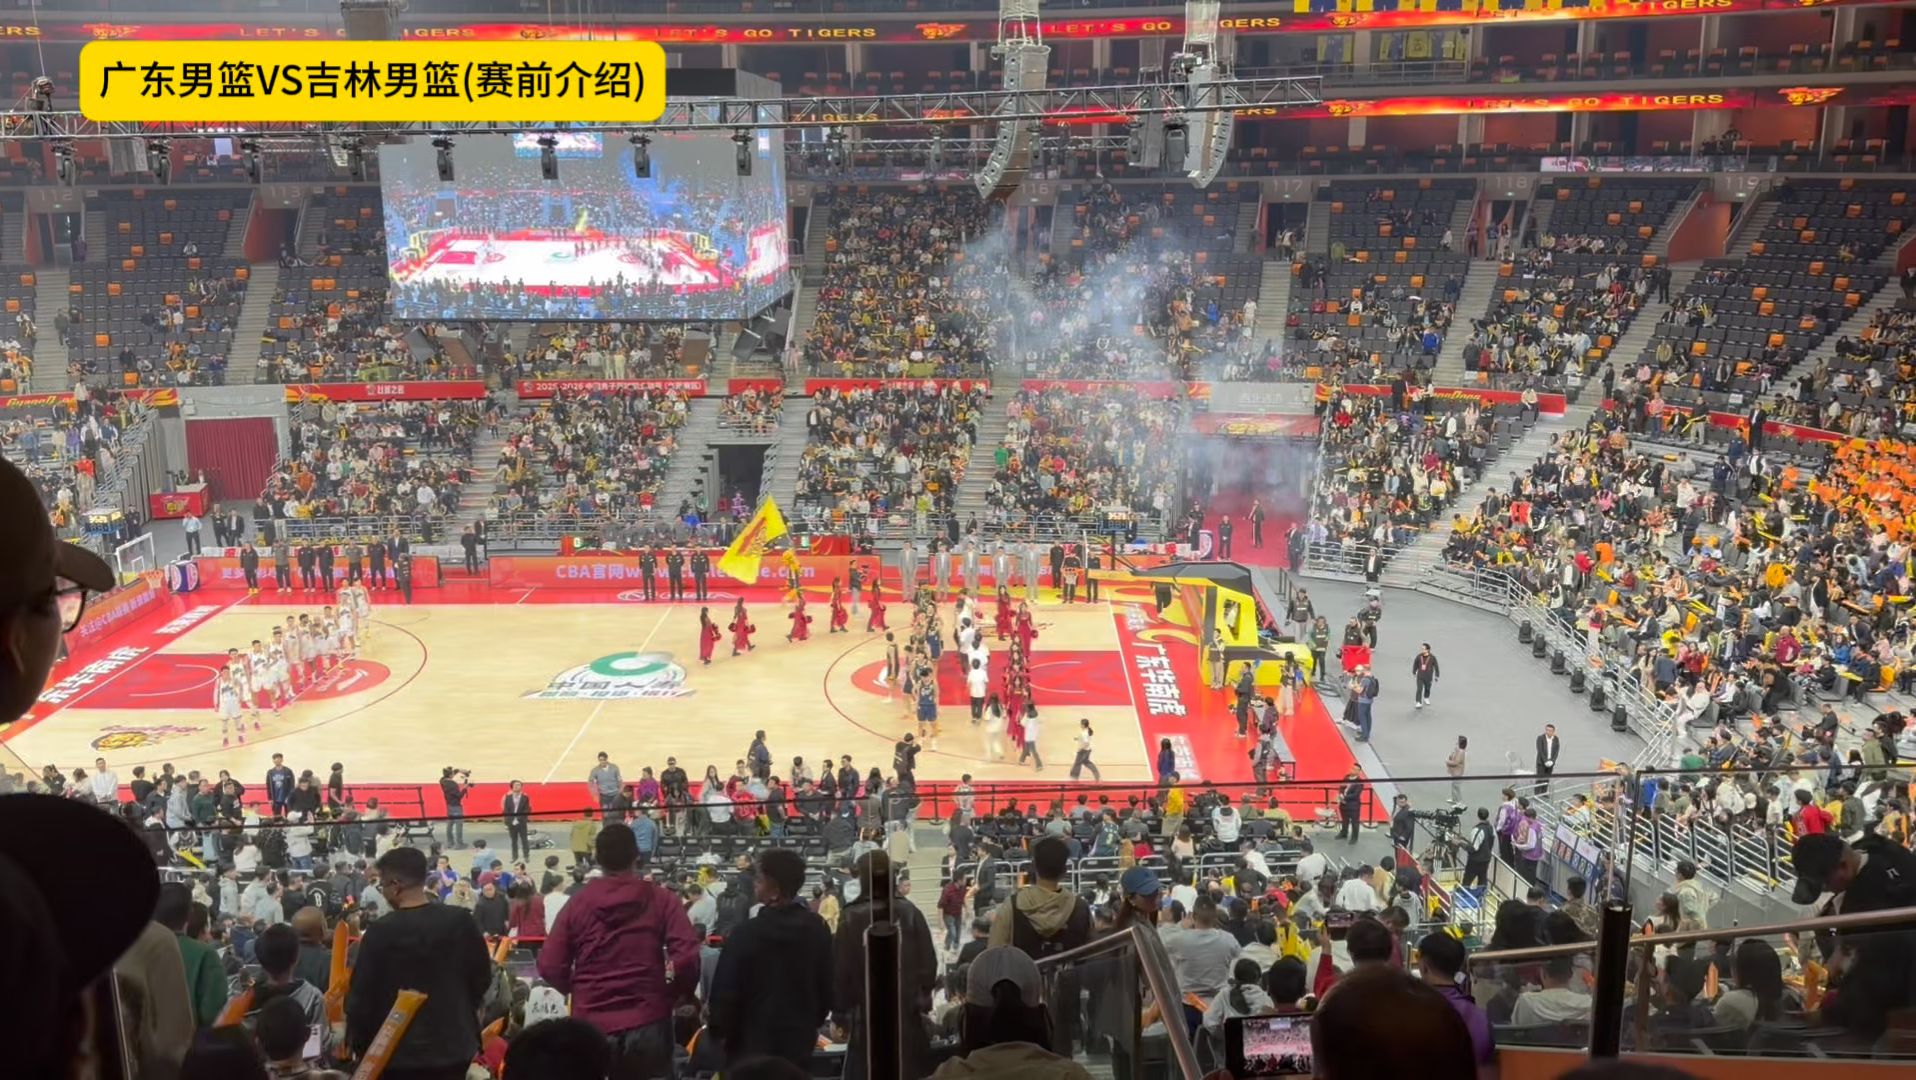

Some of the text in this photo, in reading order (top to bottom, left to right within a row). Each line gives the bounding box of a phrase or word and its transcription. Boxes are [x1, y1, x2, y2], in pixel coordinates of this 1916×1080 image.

[1051, 21, 1171, 33] LET'S GO
[1219, 17, 1280, 28] GERS
[336, 28, 347, 37] G
[404, 27, 474, 37] IGERS
[743, 28, 773, 38] GO
[788, 27, 876, 38] TIGERS
[1623, 94, 1724, 105] TIGERS
[1233, 107, 1277, 116] ERS
[1272, 179, 1303, 192] 117
[1495, 176, 1527, 189] 118
[269, 185, 300, 198] 113
[1020, 182, 1049, 195] 116
[39, 190, 73, 201] 112
[32, 646, 150, 708] 东华南虎
